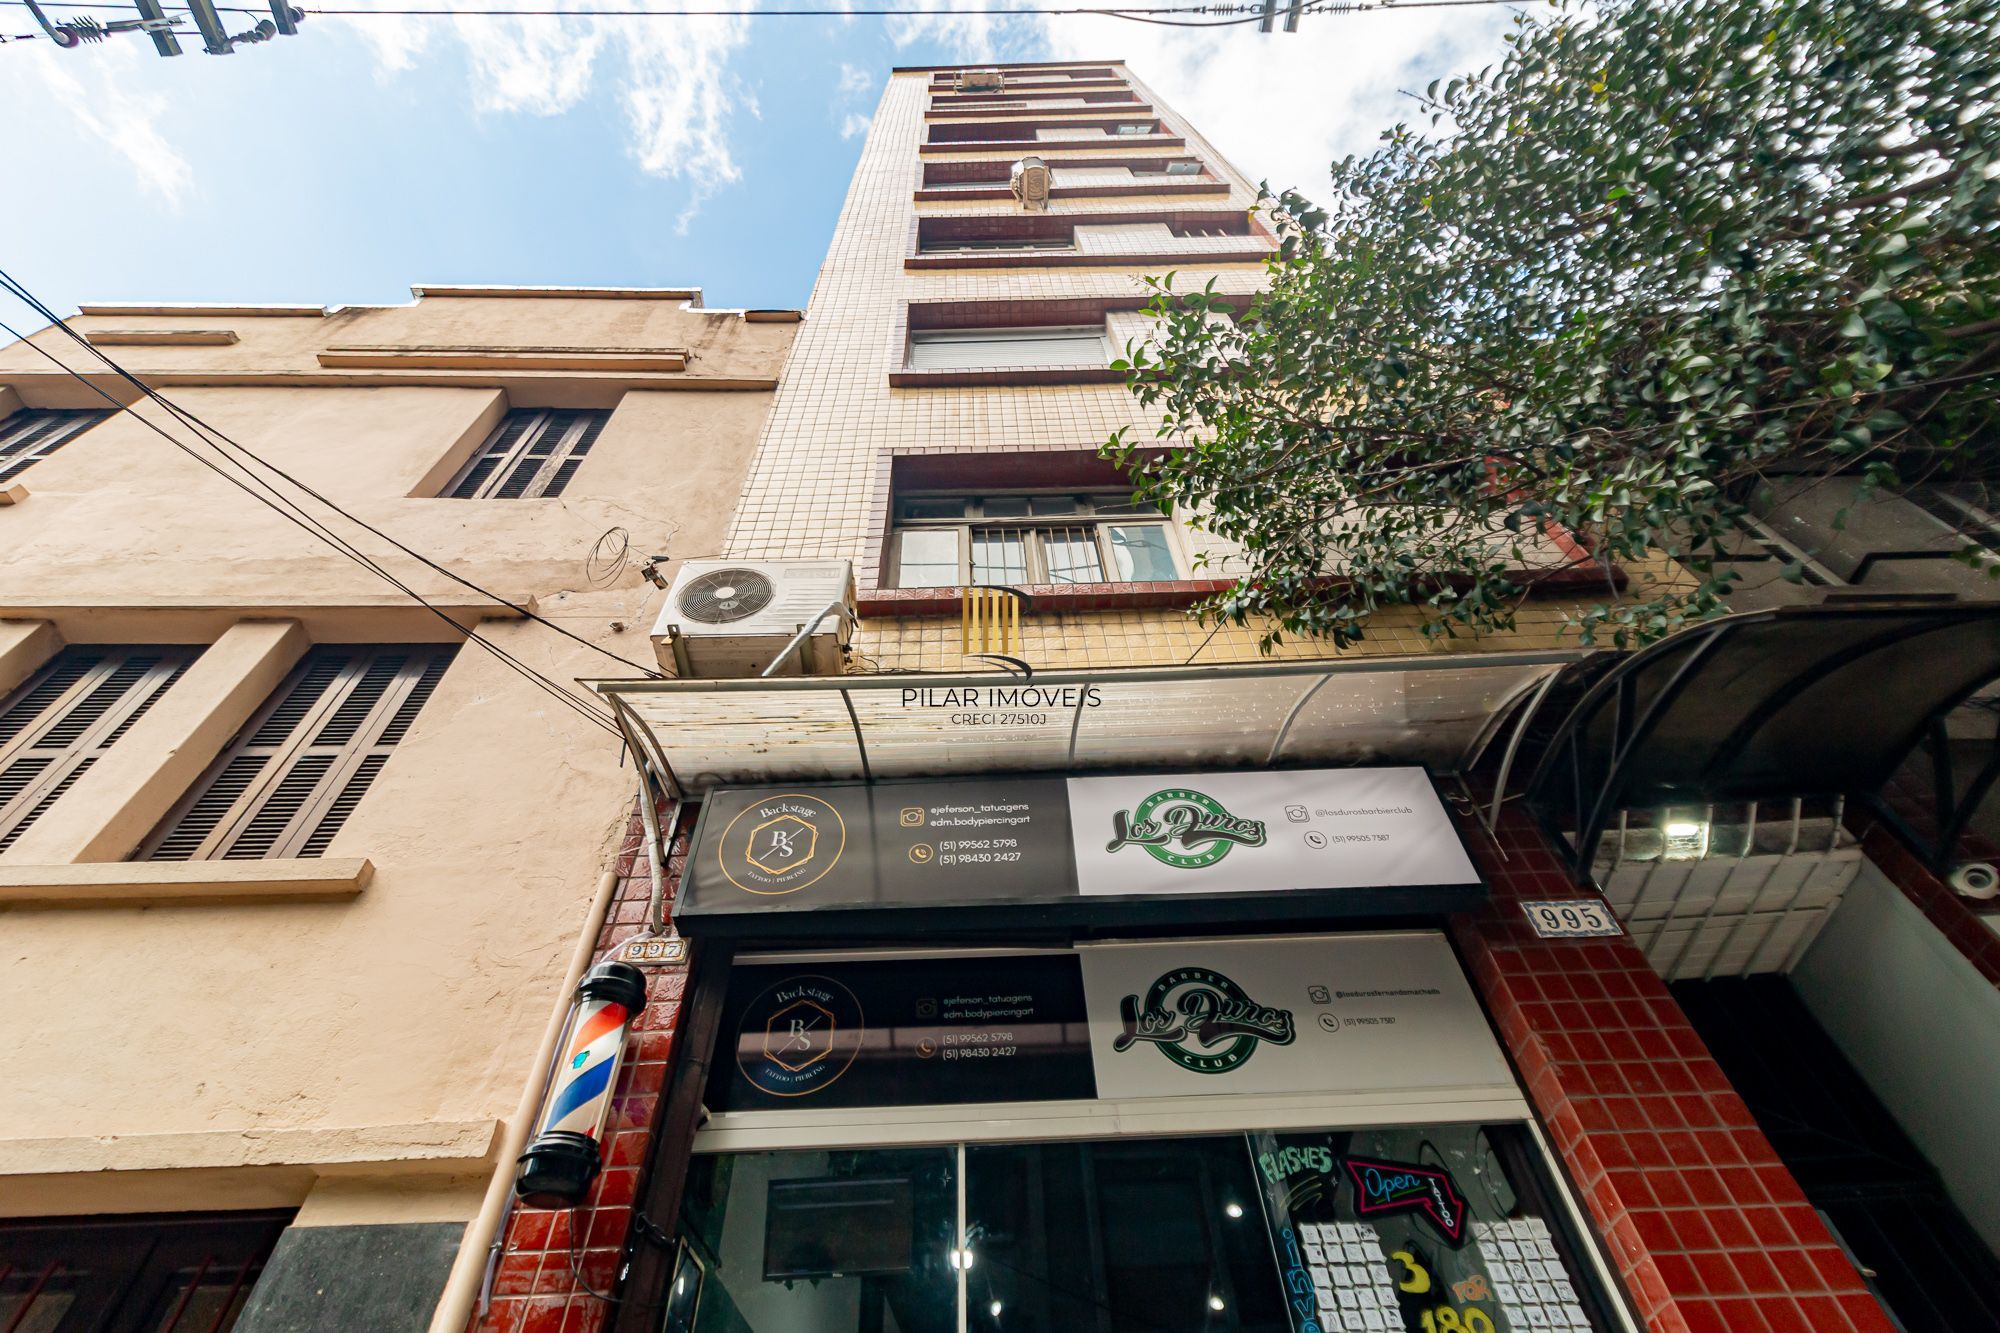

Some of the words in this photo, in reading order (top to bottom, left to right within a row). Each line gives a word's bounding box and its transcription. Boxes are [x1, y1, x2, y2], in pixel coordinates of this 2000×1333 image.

[1145, 790, 1211, 808] BARBER
[760, 802, 817, 819] Backstage
[1105, 809, 1171, 854] Los
[1164, 804, 1268, 851] Duros
[939, 840, 957, 853] (51)
[958, 839, 990, 849] 99562
[992, 838, 1018, 848] 5798
[939, 854, 957, 866] (51)
[958, 853, 992, 864] 98430
[993, 852, 1021, 862] 2427
[1167, 853, 1215, 866] CLUB
[1539, 906, 1602, 930] 995
[631, 944, 678, 956] 997
[1157, 972, 1230, 992] BARBER
[776, 984, 834, 1003] Backstage
[1112, 994, 1188, 1053] Los
[1176, 988, 1297, 1048] Duros
[943, 1034, 958, 1046] (51)
[959, 1033, 989, 1043] 99562
[991, 1032, 1014, 1042] 5798
[943, 1049, 958, 1061] (51)
[960, 1047, 990, 1058] 98430
[992, 1046, 1017, 1057] 2427
[1183, 1052, 1239, 1069] CLUB
[1259, 1145, 1333, 1185] FLASHES
[1366, 1168, 1421, 1202] Open
[1391, 1251, 1431, 1294] 3
[1452, 1274, 1497, 1304] FOR
